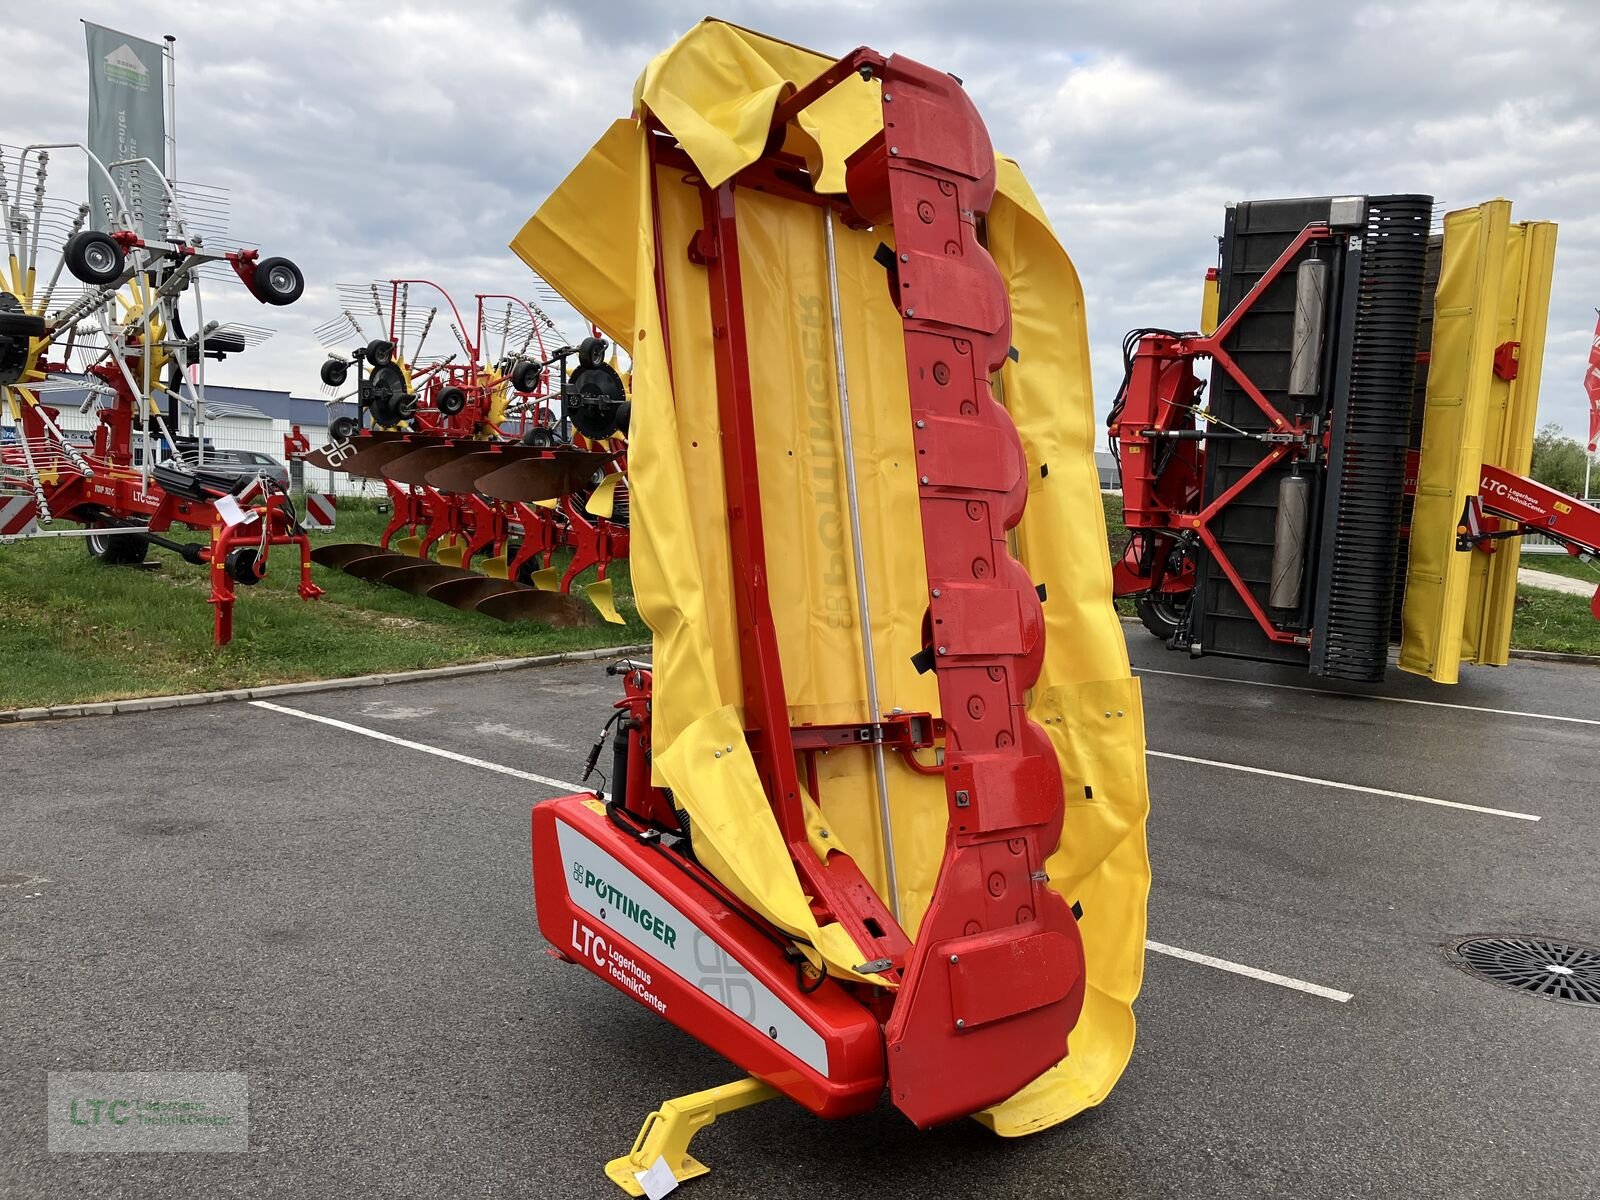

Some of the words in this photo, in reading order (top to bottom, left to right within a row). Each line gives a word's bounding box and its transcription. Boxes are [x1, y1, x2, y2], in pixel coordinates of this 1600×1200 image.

[1481, 477, 1508, 495] LTC
[1509, 488, 1538, 504] Lagerhaus
[1507, 494, 1546, 514] TechnikCenter
[571, 919, 607, 967] LTC
[608, 944, 652, 986] Lagerhaus
[607, 961, 668, 1014] TechnikCenter
